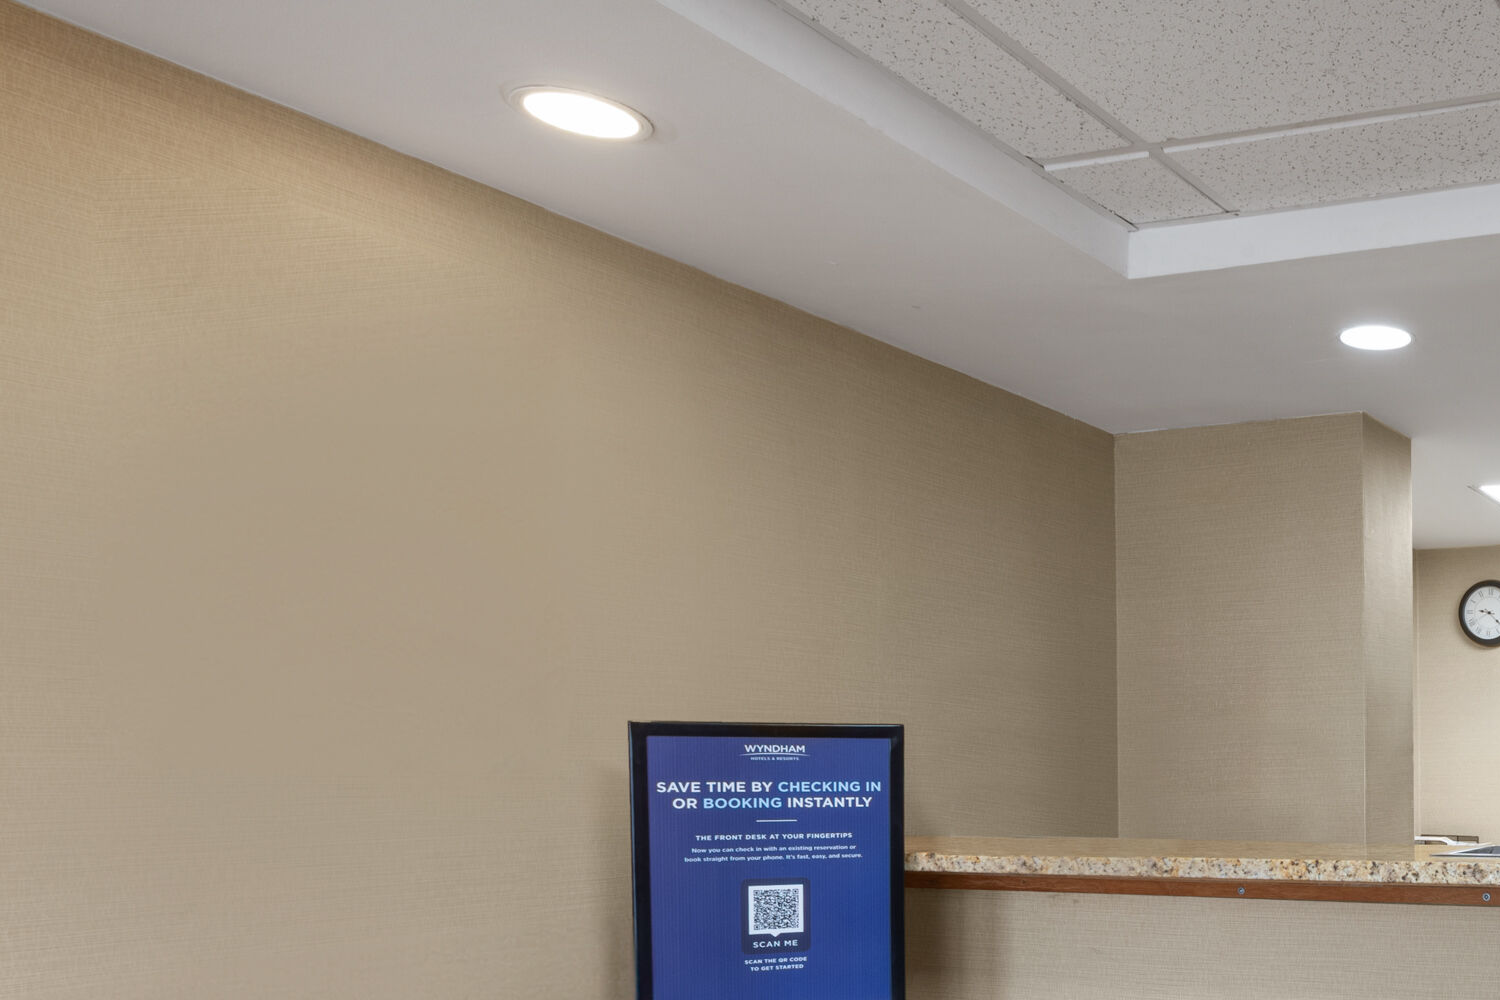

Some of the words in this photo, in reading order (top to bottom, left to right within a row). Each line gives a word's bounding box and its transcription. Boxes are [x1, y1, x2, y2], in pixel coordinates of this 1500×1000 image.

[744, 744, 806, 753] WYNDHAM
[656, 781, 701, 793] SAVE
[706, 781, 746, 793] TIME
[751, 781, 773, 793] BY
[778, 781, 861, 792] CHECKING
[865, 781, 882, 792] IN
[672, 798, 698, 809] OR
[703, 797, 782, 809] BOOKING
[787, 796, 872, 808] INSTANTLY
[753, 941, 780, 949] SCAN
[784, 939, 798, 947] ME
